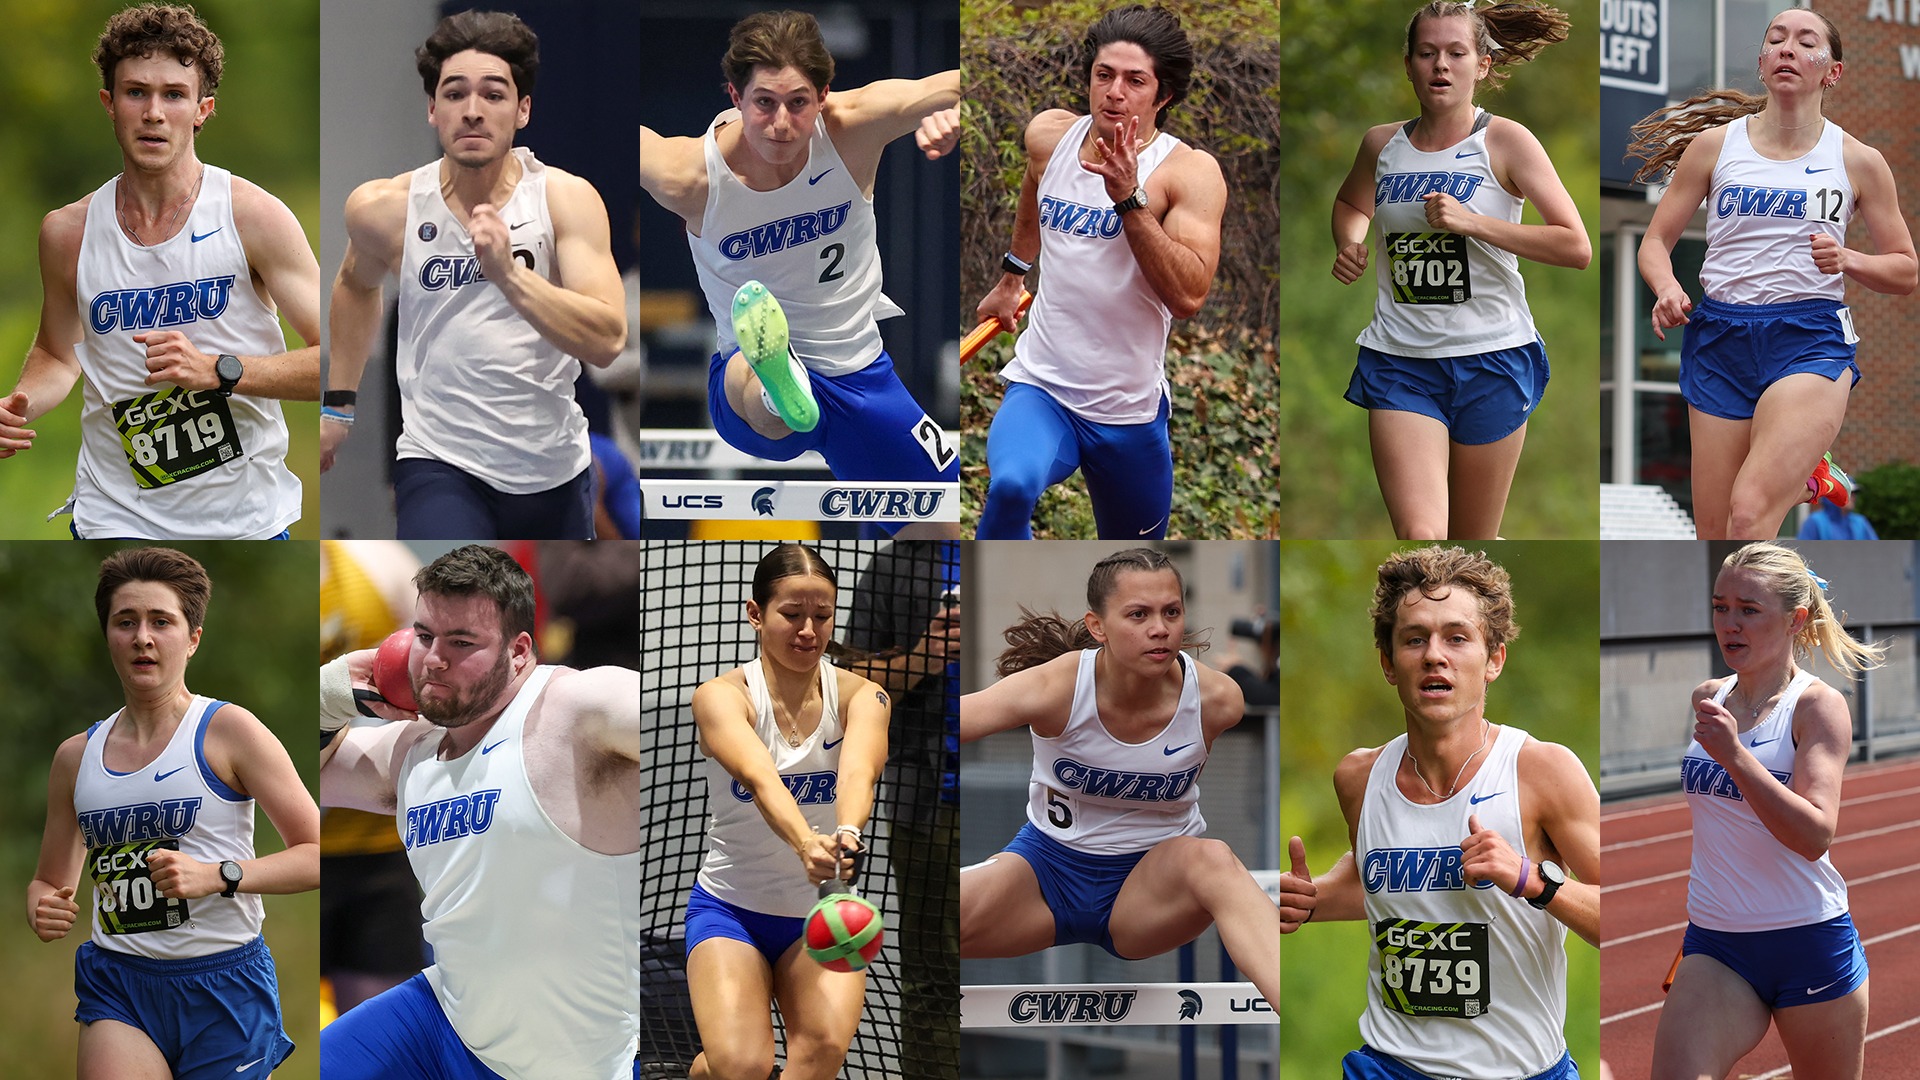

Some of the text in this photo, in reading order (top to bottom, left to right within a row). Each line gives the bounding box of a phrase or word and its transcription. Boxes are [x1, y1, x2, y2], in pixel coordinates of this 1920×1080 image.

[1600, 32, 1651, 75] LEFT
[1376, 171, 1484, 207] CWRU
[1717, 184, 1807, 219] CWR
[1816, 188, 1843, 223] 12
[719, 200, 852, 261] CWRU
[1040, 195, 1124, 240] CWRU
[818, 243, 845, 284] 2
[1394, 239, 1456, 254] GCXC
[1393, 260, 1464, 287] 8702
[90, 274, 236, 334] CWRU
[124, 389, 210, 426] GCXC
[131, 412, 225, 467] 8719
[919, 420, 955, 467] 2
[662, 488, 945, 518] UCS CWRU
[1053, 758, 1200, 802] CWRU
[78, 797, 202, 850] CWRU
[405, 789, 502, 851] CWRU
[1047, 788, 1073, 829] 5
[1363, 846, 1495, 894] CWR
[1387, 926, 1471, 951] GCXC
[1385, 954, 1481, 995] 8739
[1008, 990, 1274, 1023] CWRU UC
